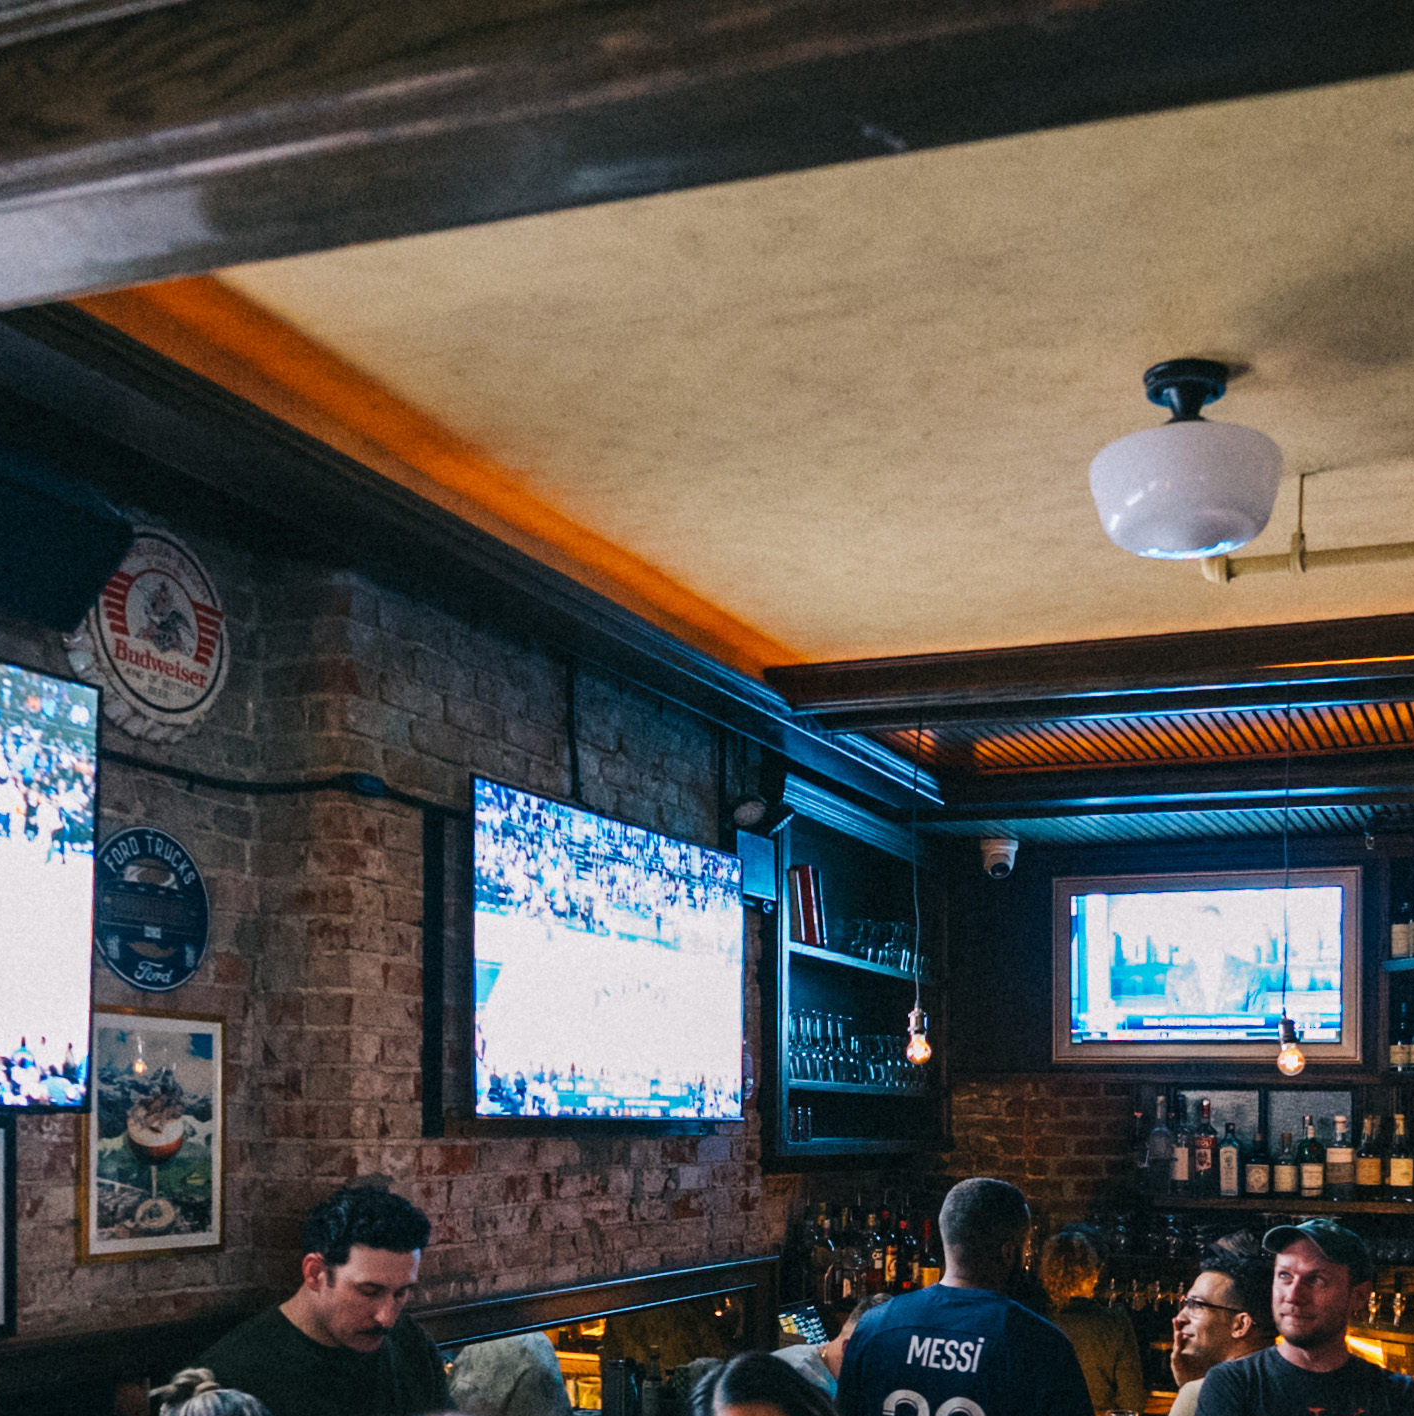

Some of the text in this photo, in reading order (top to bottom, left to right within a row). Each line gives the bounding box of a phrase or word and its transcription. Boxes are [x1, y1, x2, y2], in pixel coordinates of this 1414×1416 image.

[114, 638, 208, 688] Budweiser
[104, 835, 196, 885] FORD TRUCKS
[134, 961, 173, 983] Ford
